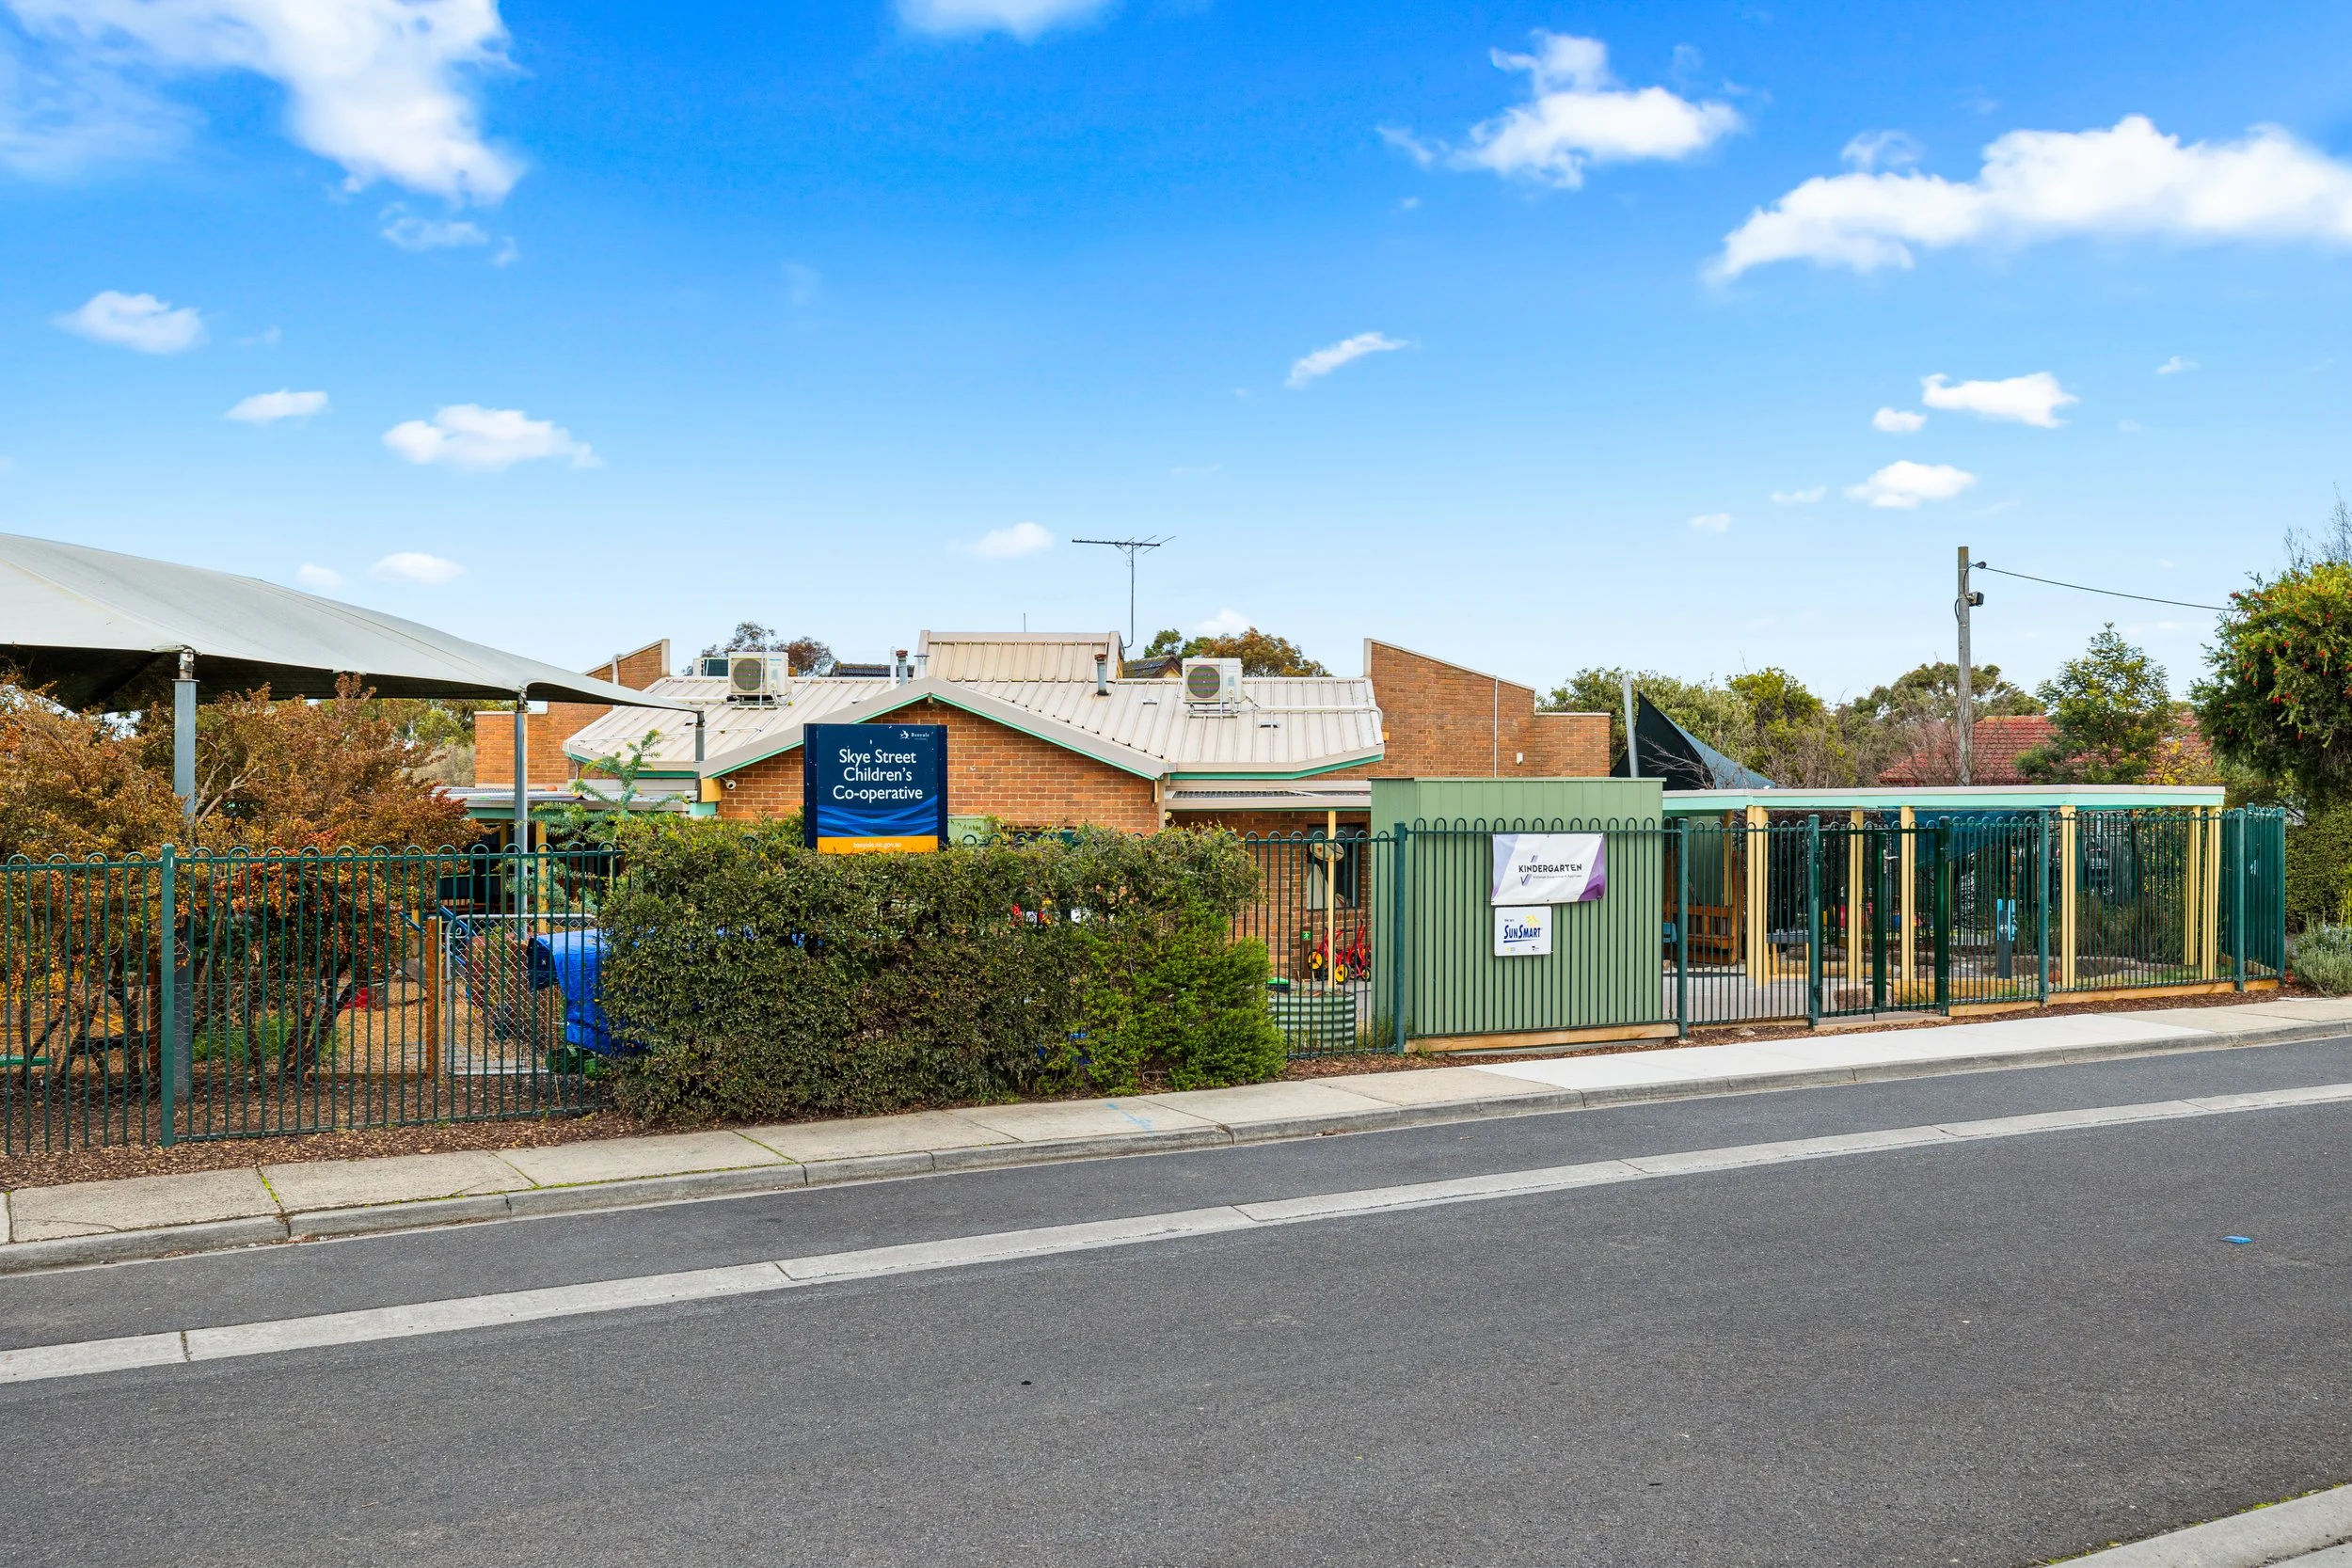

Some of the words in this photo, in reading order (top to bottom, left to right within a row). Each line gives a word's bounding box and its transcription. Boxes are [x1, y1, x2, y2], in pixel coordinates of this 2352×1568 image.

[838, 748, 871, 768] Skye
[875, 749, 917, 764] Street
[843, 767, 913, 782] Children’s
[833, 784, 923, 803] Co-operative
[1518, 863, 1582, 873] KINDERGARTEN
